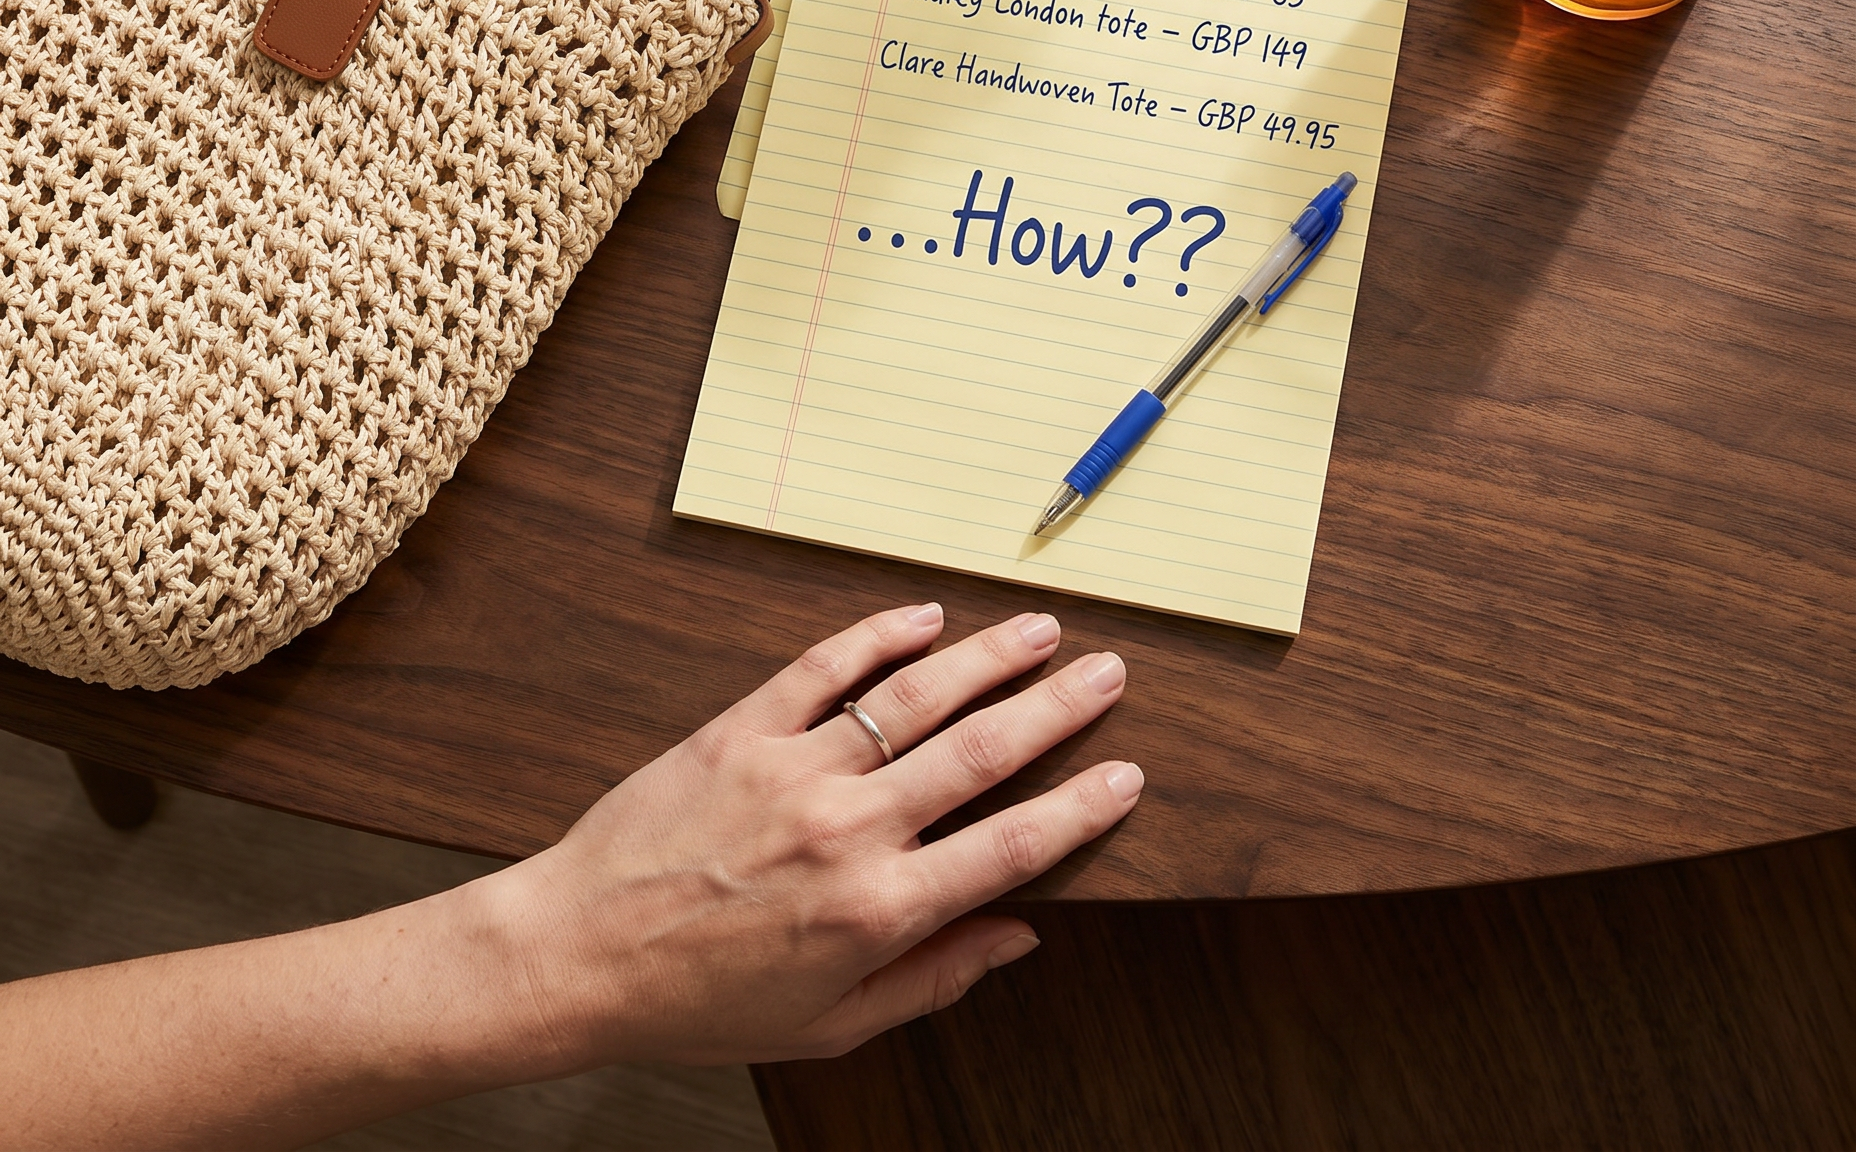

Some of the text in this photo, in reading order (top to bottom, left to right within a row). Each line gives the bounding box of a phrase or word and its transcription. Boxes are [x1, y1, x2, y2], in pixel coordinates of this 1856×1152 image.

[1096, 3, 1149, 41] tote
[1191, 19, 1254, 58] GBP
[1261, 33, 1309, 70] 149
[880, 39, 946, 79] Clare
[956, 55, 1096, 105] Handwoven
[1107, 80, 1159, 118] Tote
[1197, 97, 1257, 134] GBP
[1262, 112, 1339, 150] 49.95
[856, 168, 1227, 298] ...How??
